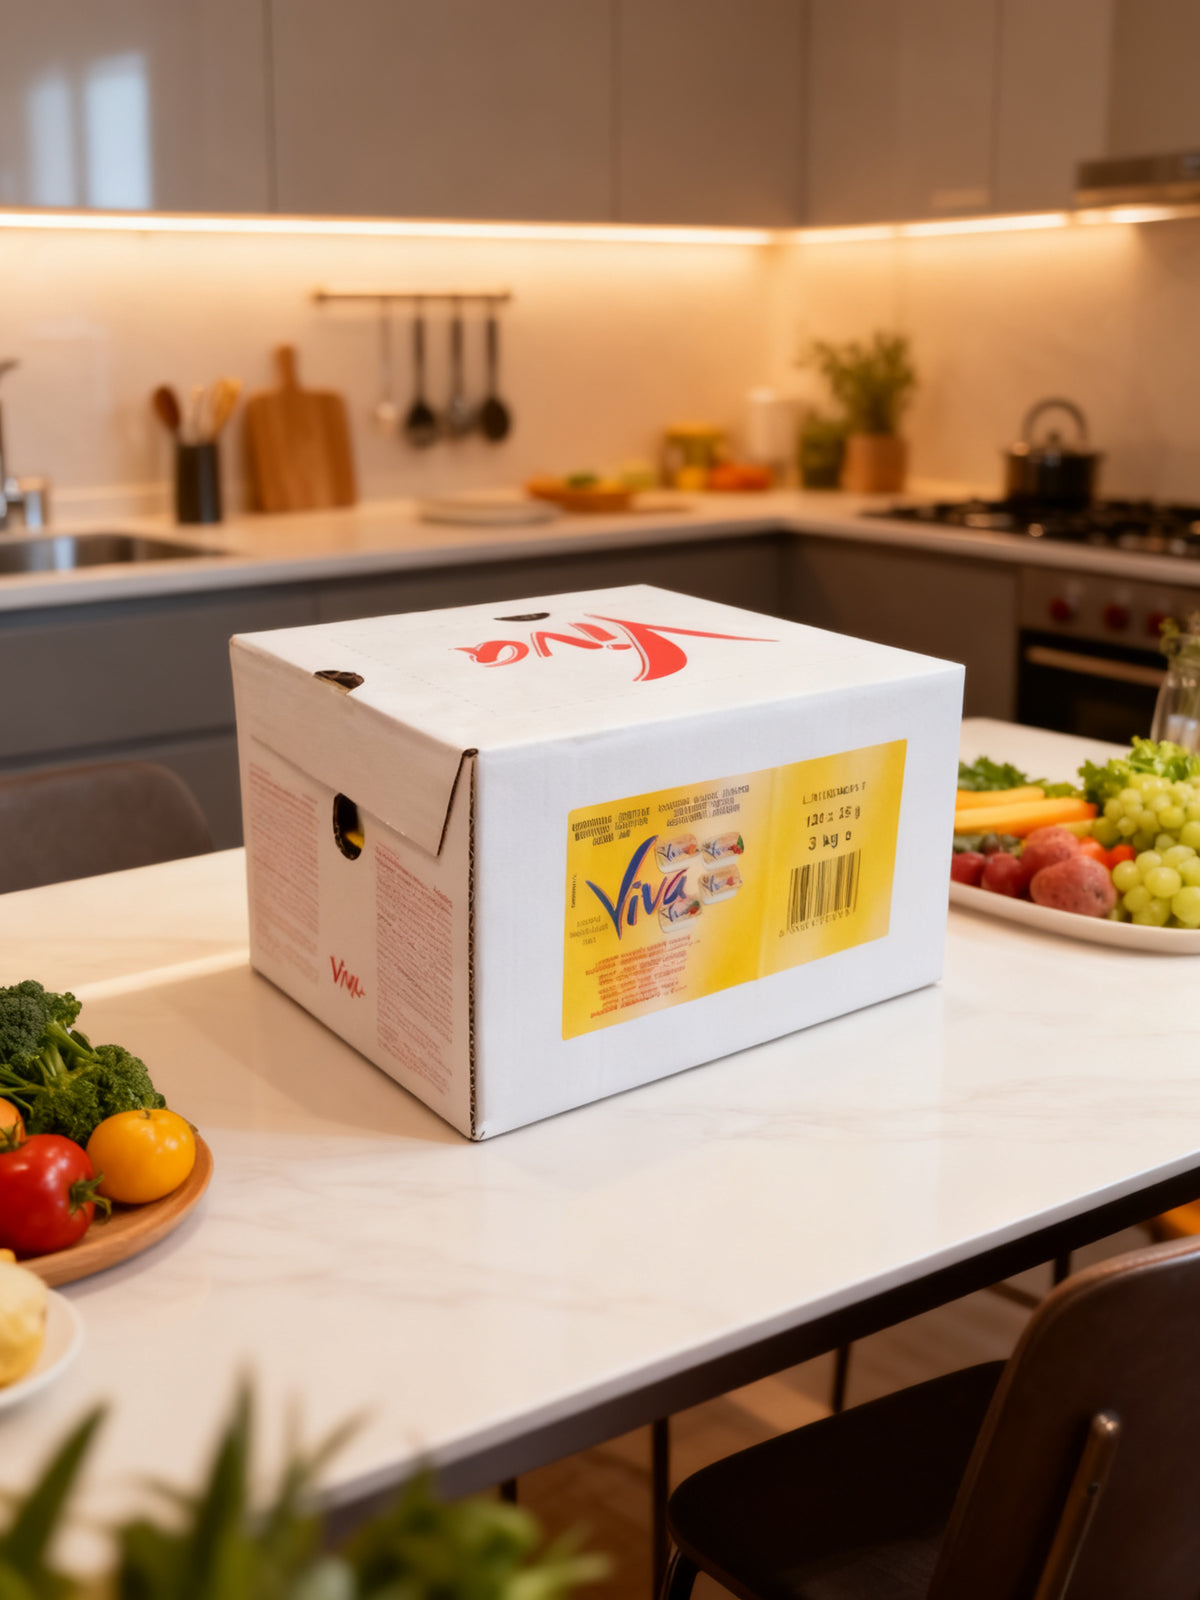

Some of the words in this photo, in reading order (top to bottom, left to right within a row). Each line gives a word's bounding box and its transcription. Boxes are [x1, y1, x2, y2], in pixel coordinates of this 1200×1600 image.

[449, 612, 781, 682] Viva
[808, 836, 817, 851] 3
[584, 834, 688, 941] Viva
